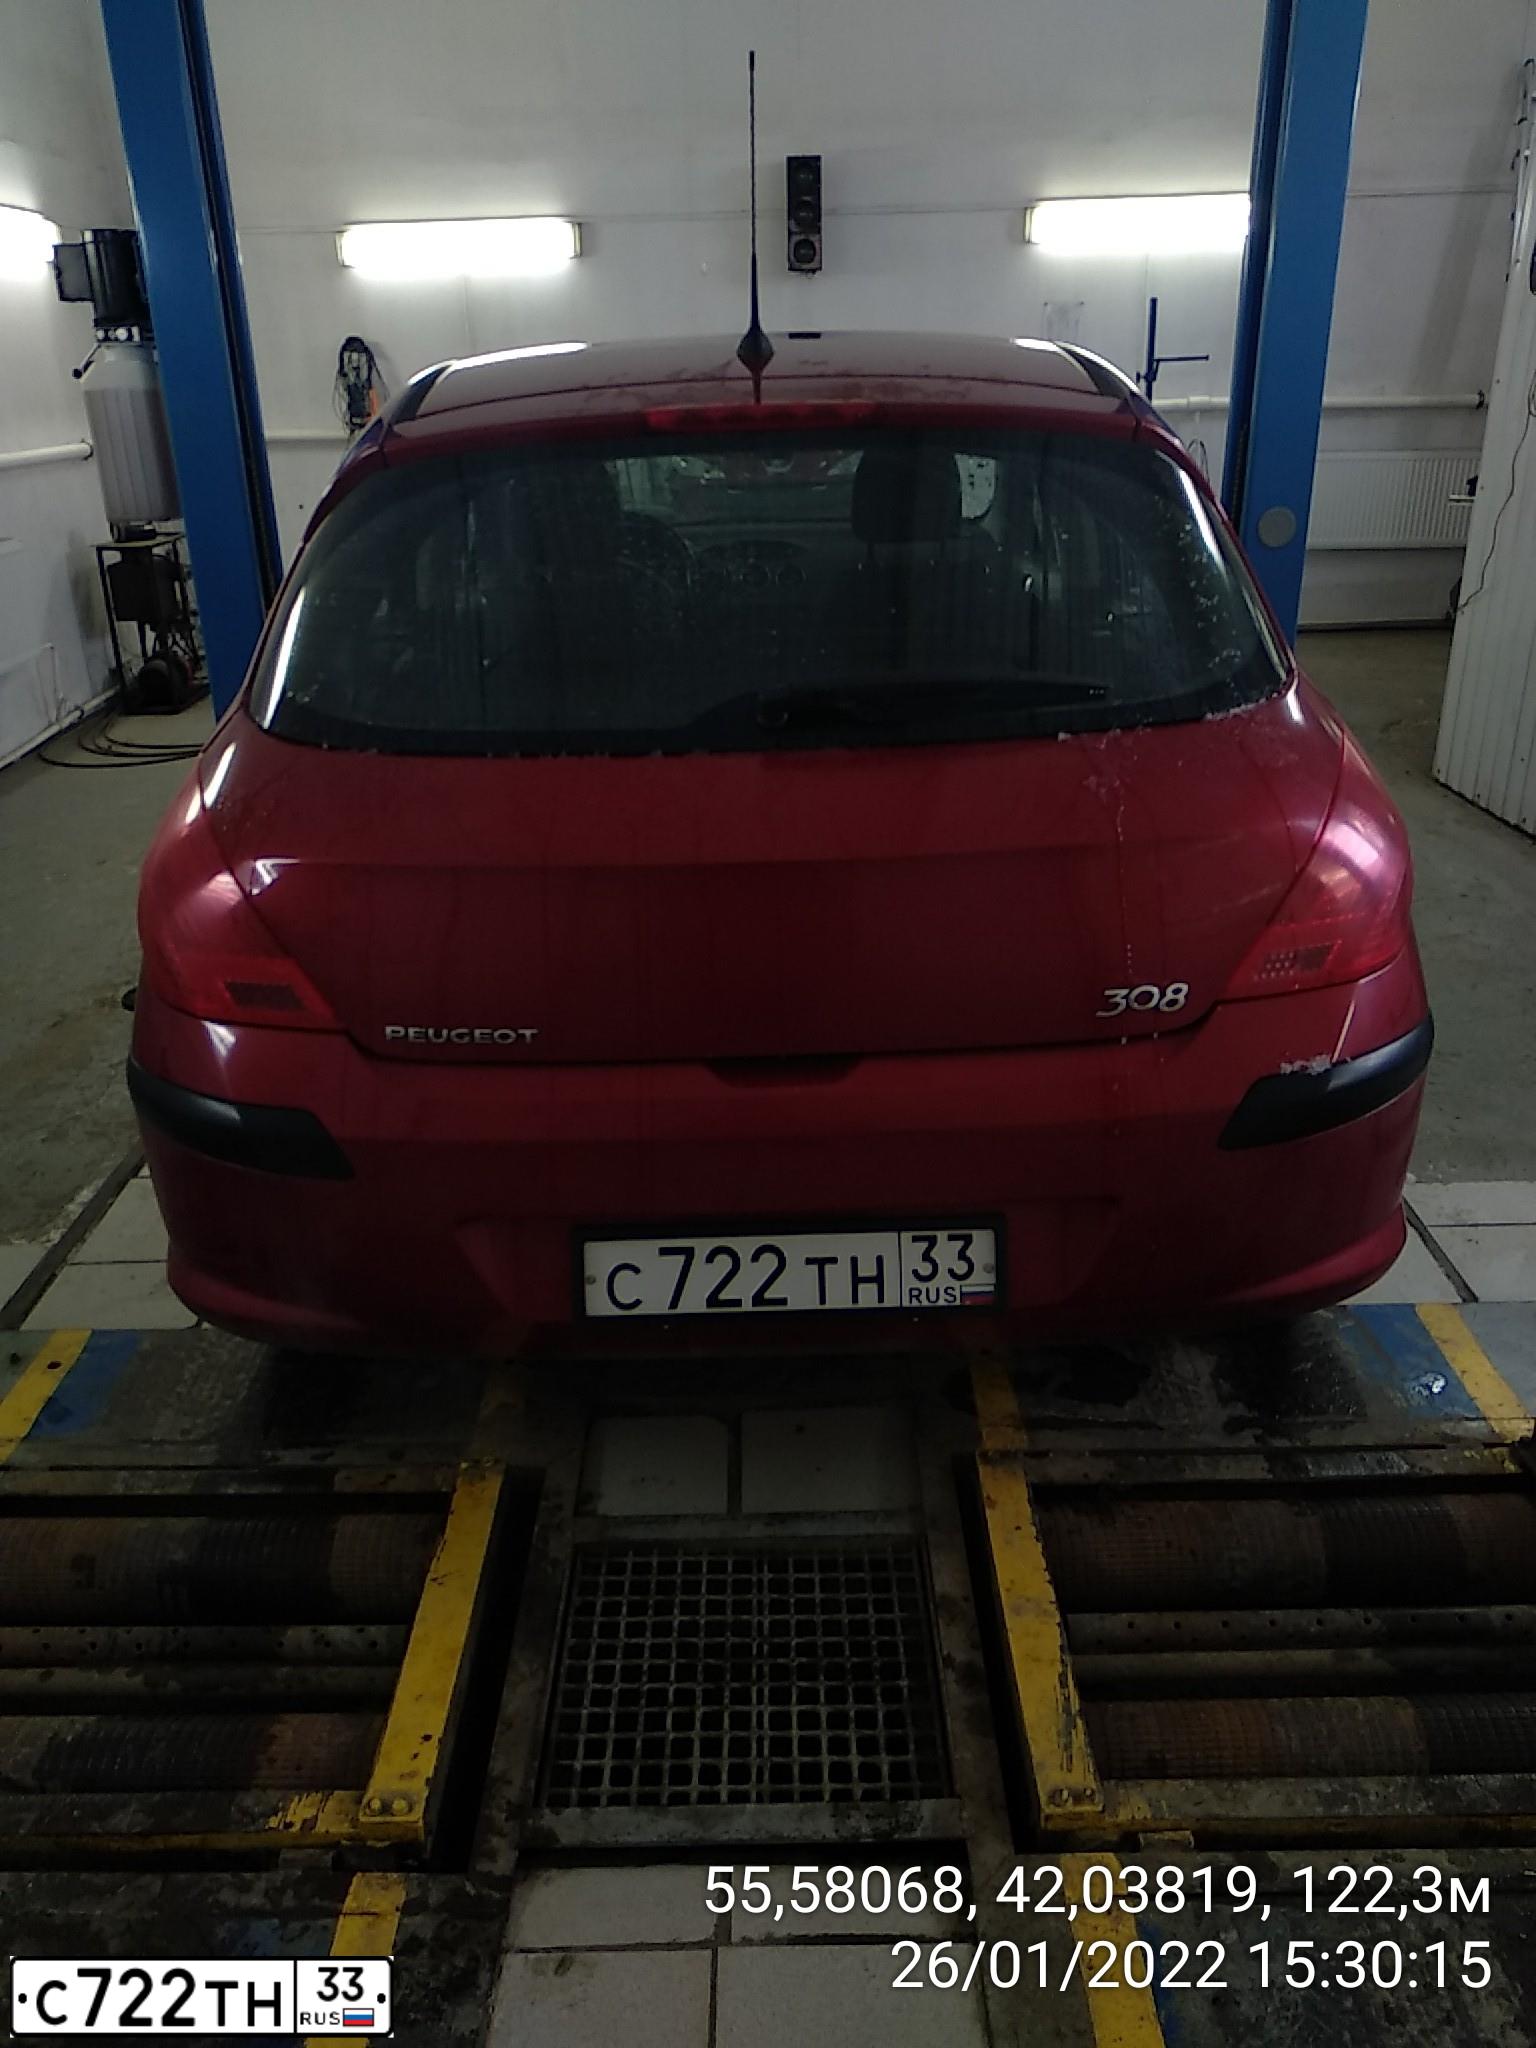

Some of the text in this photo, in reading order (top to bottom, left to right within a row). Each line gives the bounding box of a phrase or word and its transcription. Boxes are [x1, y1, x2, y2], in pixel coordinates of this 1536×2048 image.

[1095, 982, 1189, 1017] 308
[384, 1025, 538, 1044] PEUGEOT
[911, 1234, 975, 1283] 33
[908, 1286, 957, 1305] RUS
